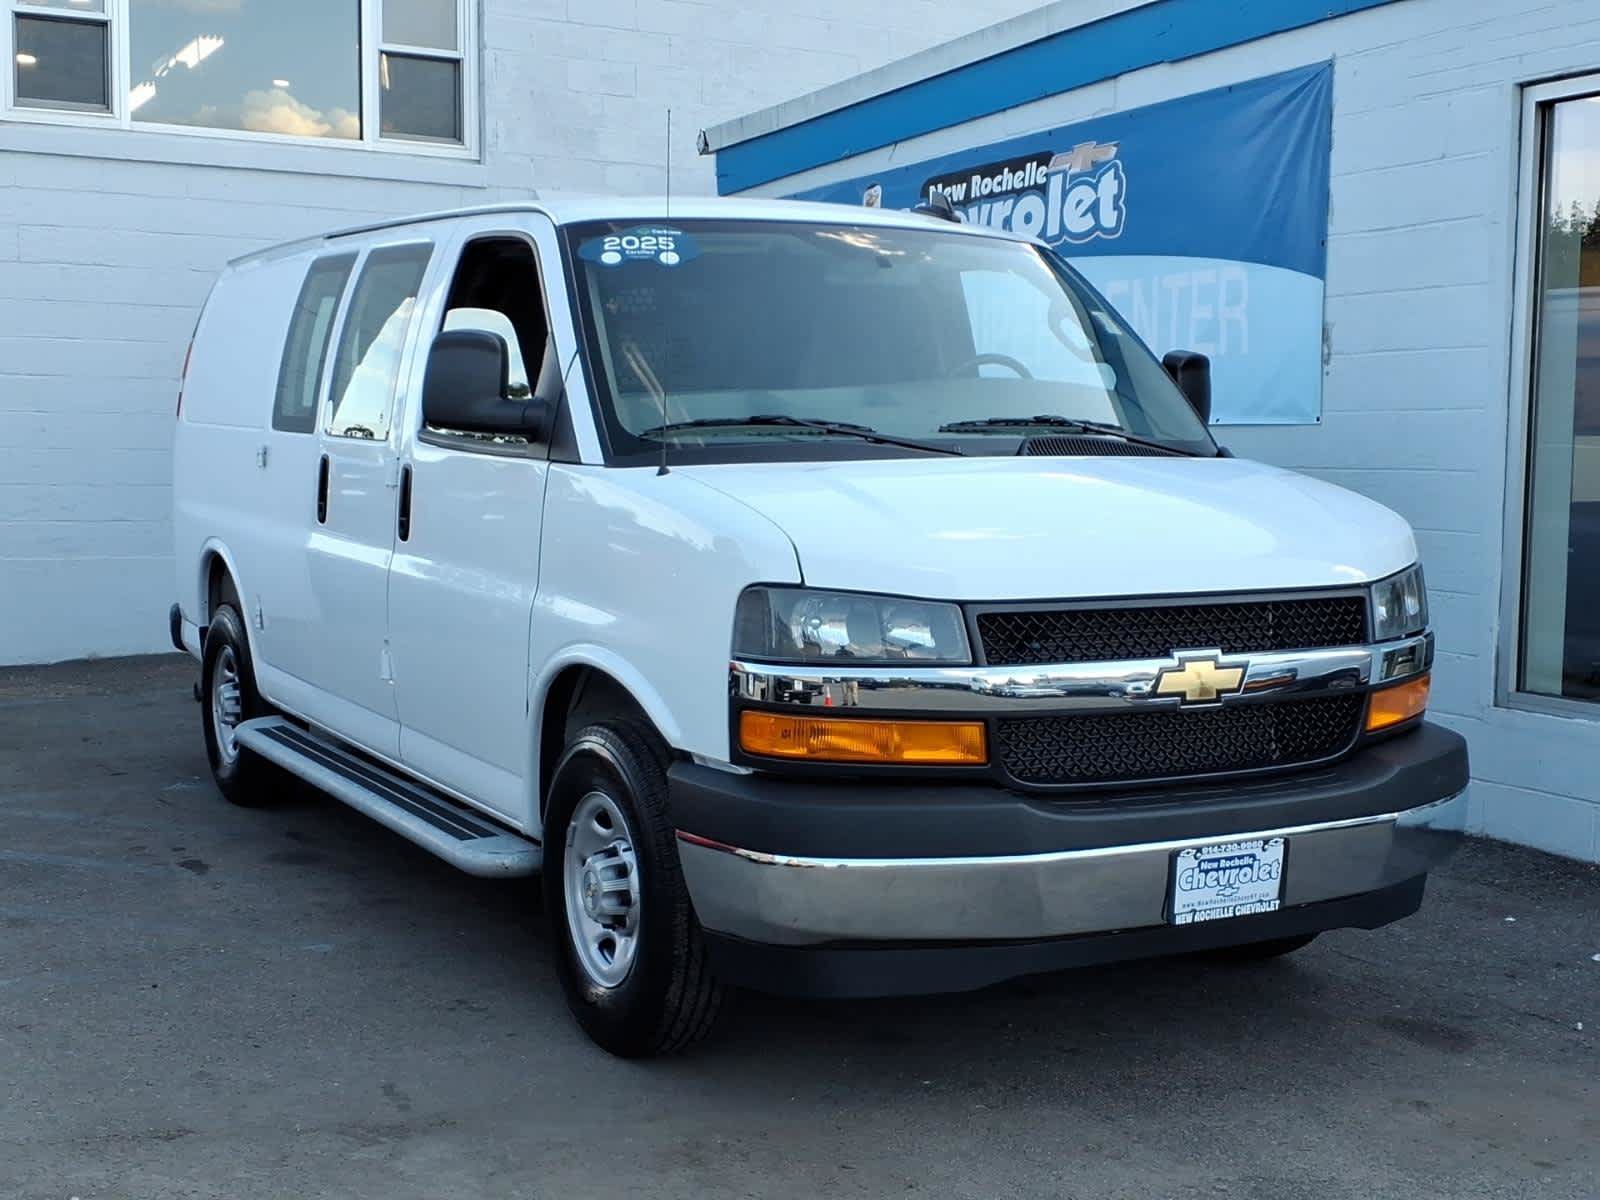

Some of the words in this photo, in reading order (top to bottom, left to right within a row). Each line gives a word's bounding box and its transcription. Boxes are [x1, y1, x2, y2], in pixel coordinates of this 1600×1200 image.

[929, 182, 967, 206] New
[971, 161, 1047, 198] Rochelle
[901, 165, 1119, 238] vrolet
[604, 235, 675, 250] 2025
[1179, 859, 1280, 891] Chevrolet
[1201, 860, 1219, 870] New
[1220, 856, 1254, 868] Rochelle
[1176, 912, 1194, 925] NEW
[1194, 905, 1234, 922] ROCHELLE
[1235, 900, 1281, 916] CHEVROLET
